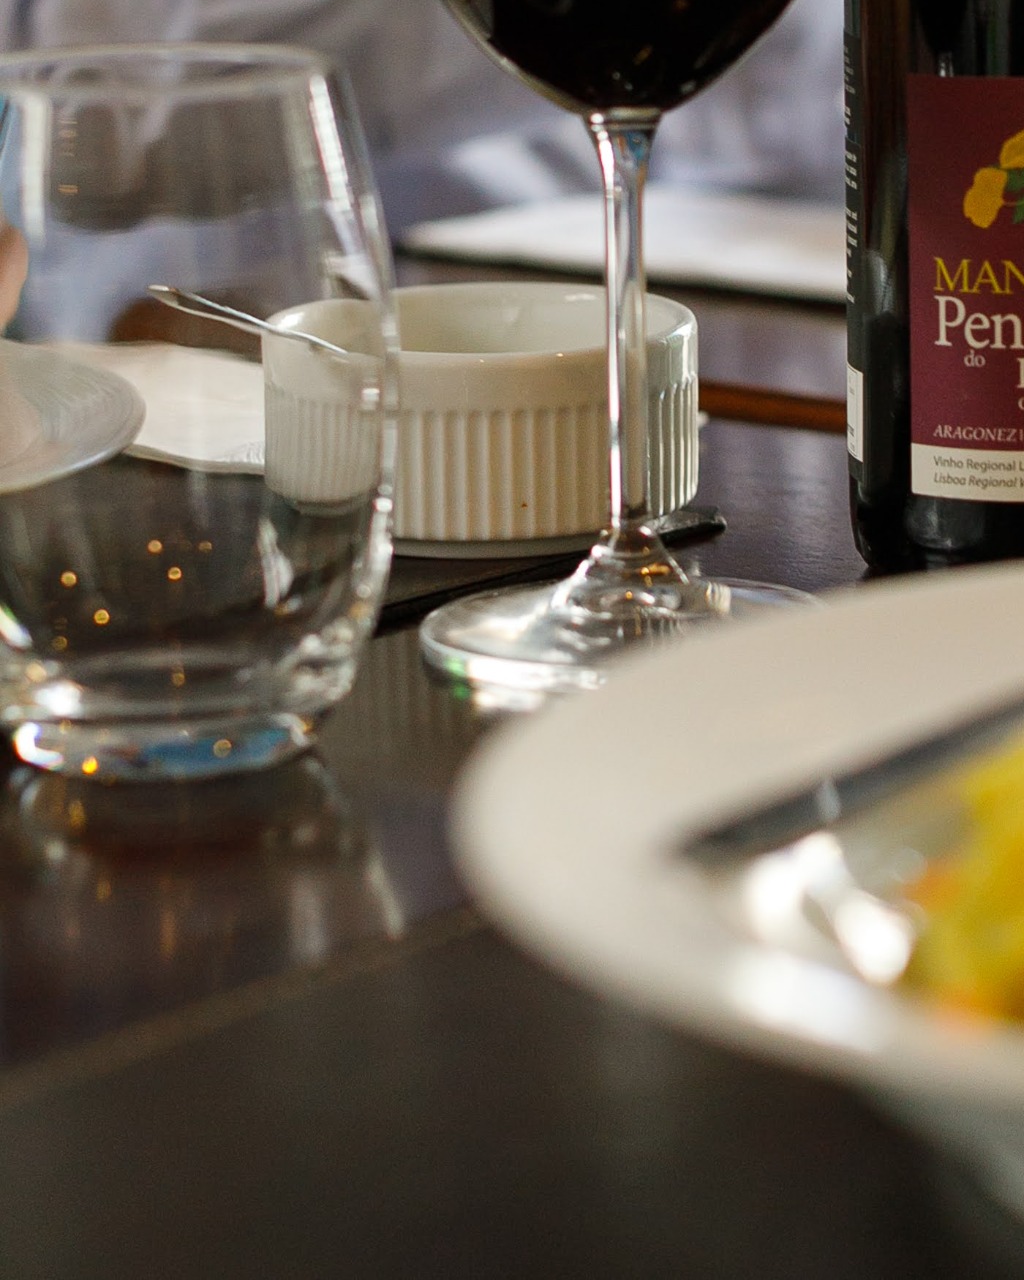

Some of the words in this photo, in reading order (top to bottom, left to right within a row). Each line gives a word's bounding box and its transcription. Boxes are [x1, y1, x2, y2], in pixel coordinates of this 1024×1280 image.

[964, 350, 986, 368] do
[933, 424, 1017, 441] ARAGONEZ
[933, 456, 964, 469] Vinho
[966, 458, 1016, 473] Regional
[933, 472, 966, 485] Lisboa
[968, 475, 1017, 489] Regional
